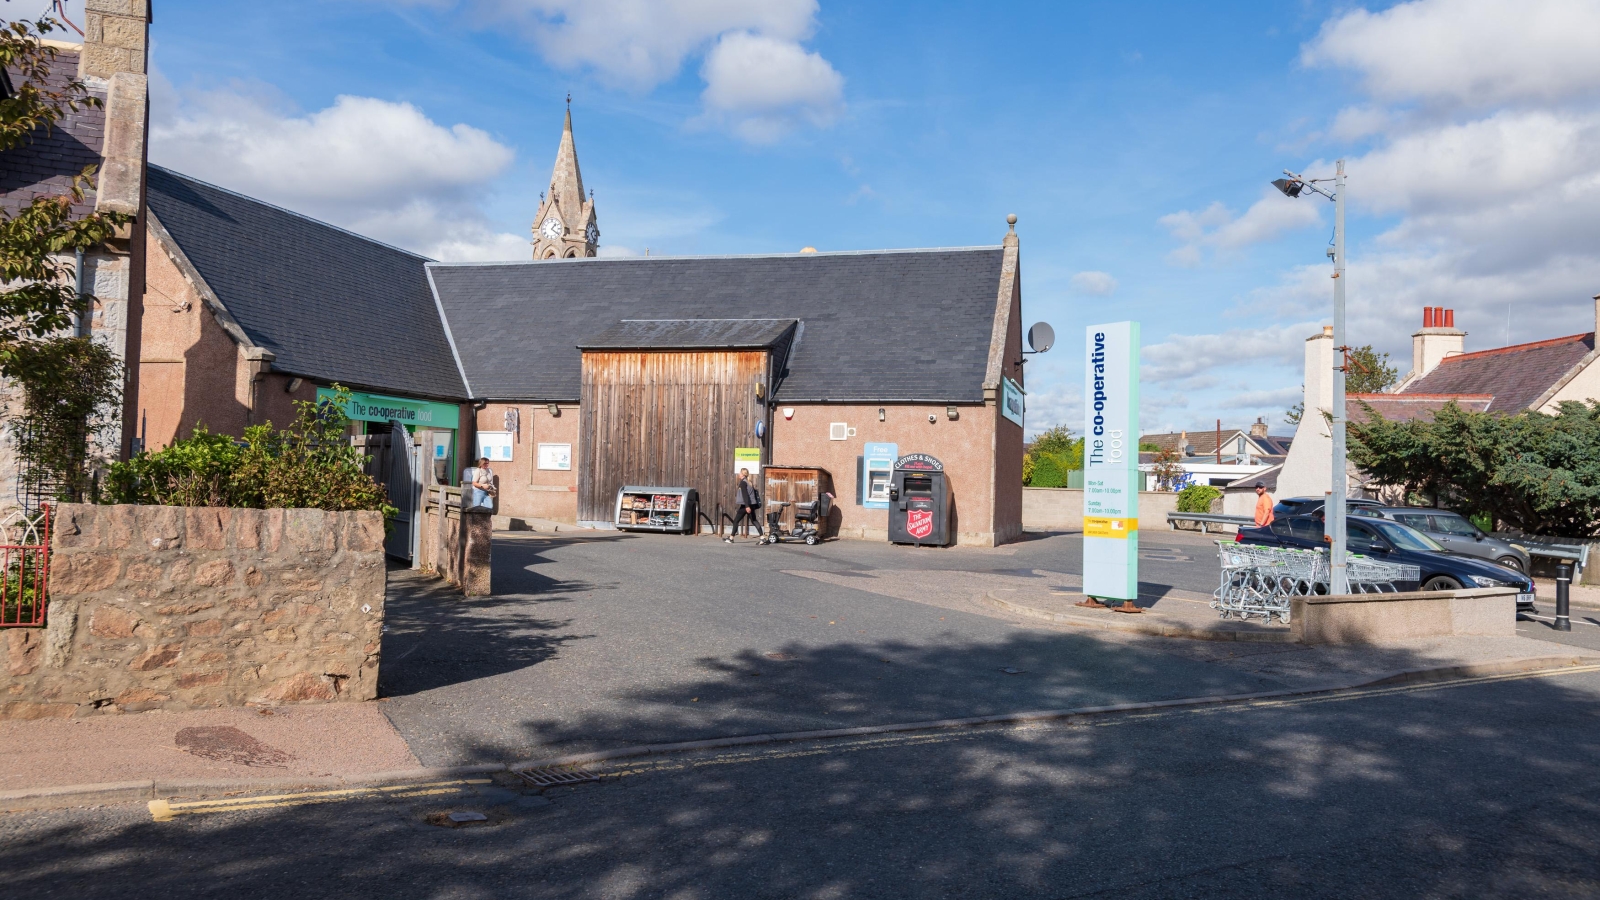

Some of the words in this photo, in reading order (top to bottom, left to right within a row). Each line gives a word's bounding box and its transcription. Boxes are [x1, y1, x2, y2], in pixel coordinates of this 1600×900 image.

[1092, 332, 1107, 436] co-operative
[352, 401, 366, 415] The
[369, 406, 415, 420] co-operative
[417, 408, 432, 422] food
[873, 445, 888, 453] Free
[1089, 439, 1104, 467] The
[1107, 429, 1123, 465] food
[894, 454, 918, 469] CLOTHES
[924, 455, 943, 470] SHOES
[908, 515, 932, 531] SALVATION
[913, 513, 922, 521] THE
[915, 523, 930, 535] ARMY
